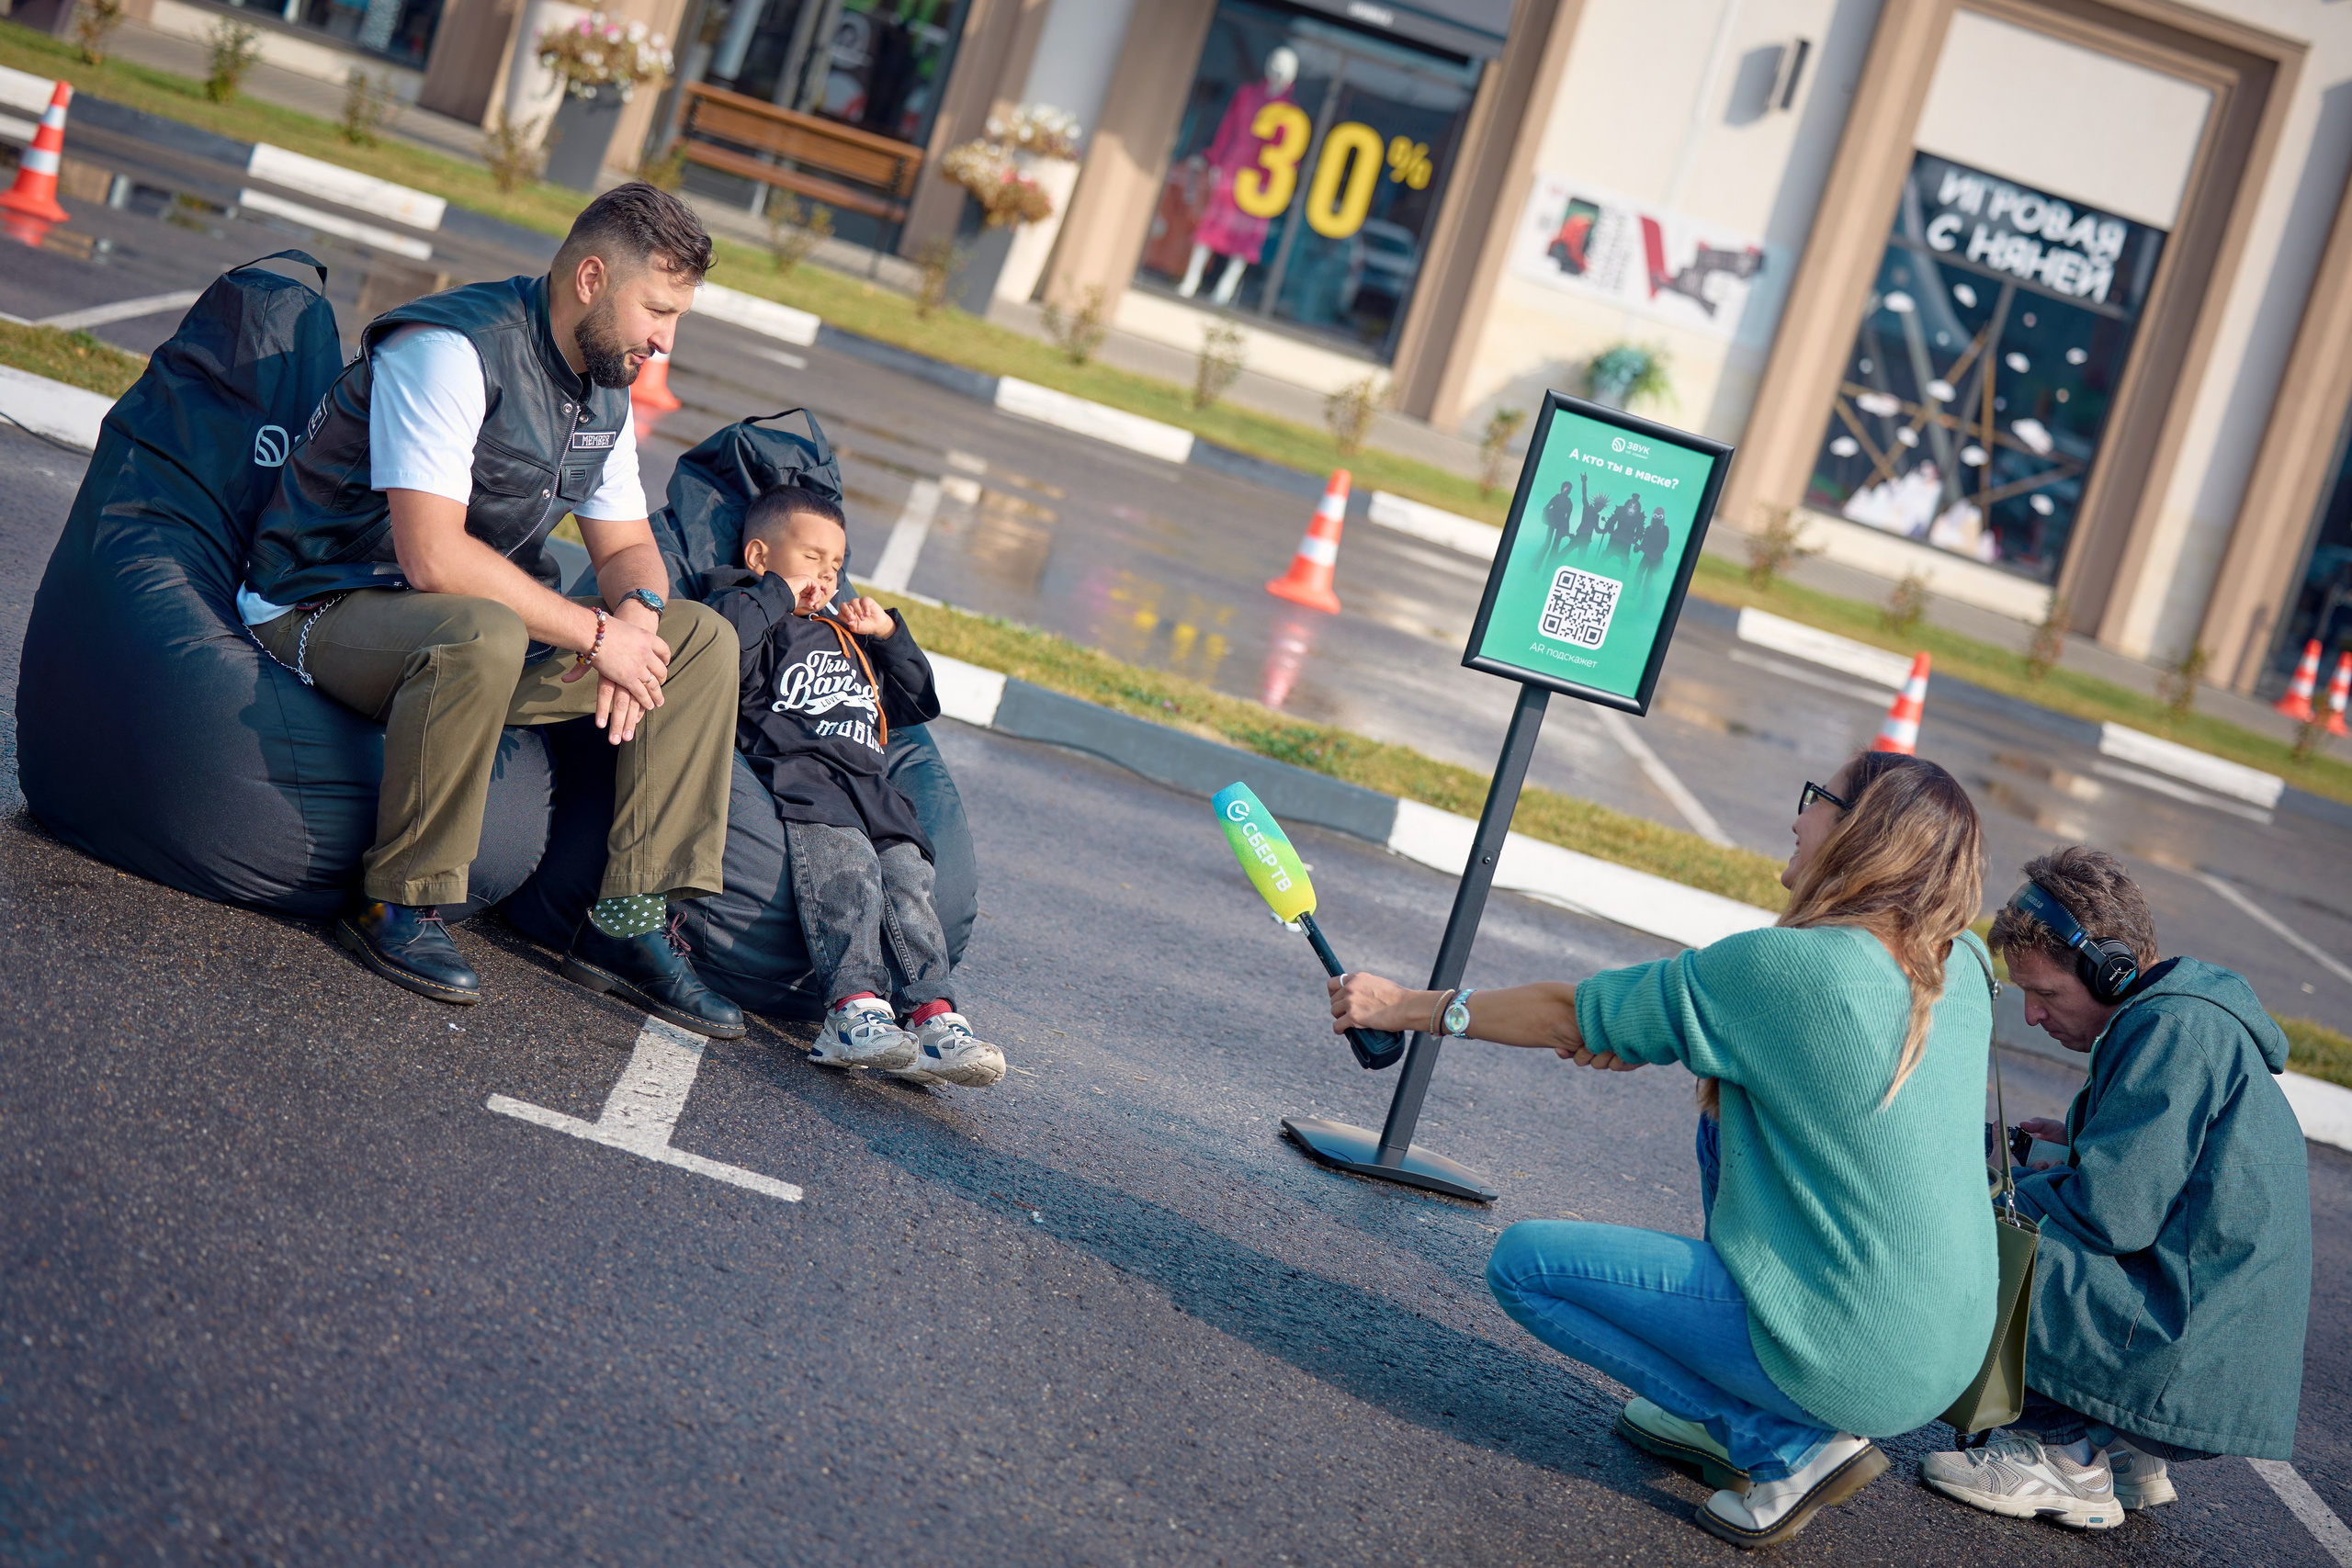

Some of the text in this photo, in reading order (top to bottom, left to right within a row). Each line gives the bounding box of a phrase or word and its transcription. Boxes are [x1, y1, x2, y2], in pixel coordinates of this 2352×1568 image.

[1938, 169, 2127, 262] ИГРОВАЯ
[1927, 213, 2115, 304] С НЯНЕЙ
[582, 434, 610, 446] MEMBER
[1627, 442, 1651, 455] ЗВУК
[1569, 448, 1679, 490] А кто ты в маске?
[1529, 642, 1598, 669] AR подскажет
[820, 695, 840, 708] LOVE
